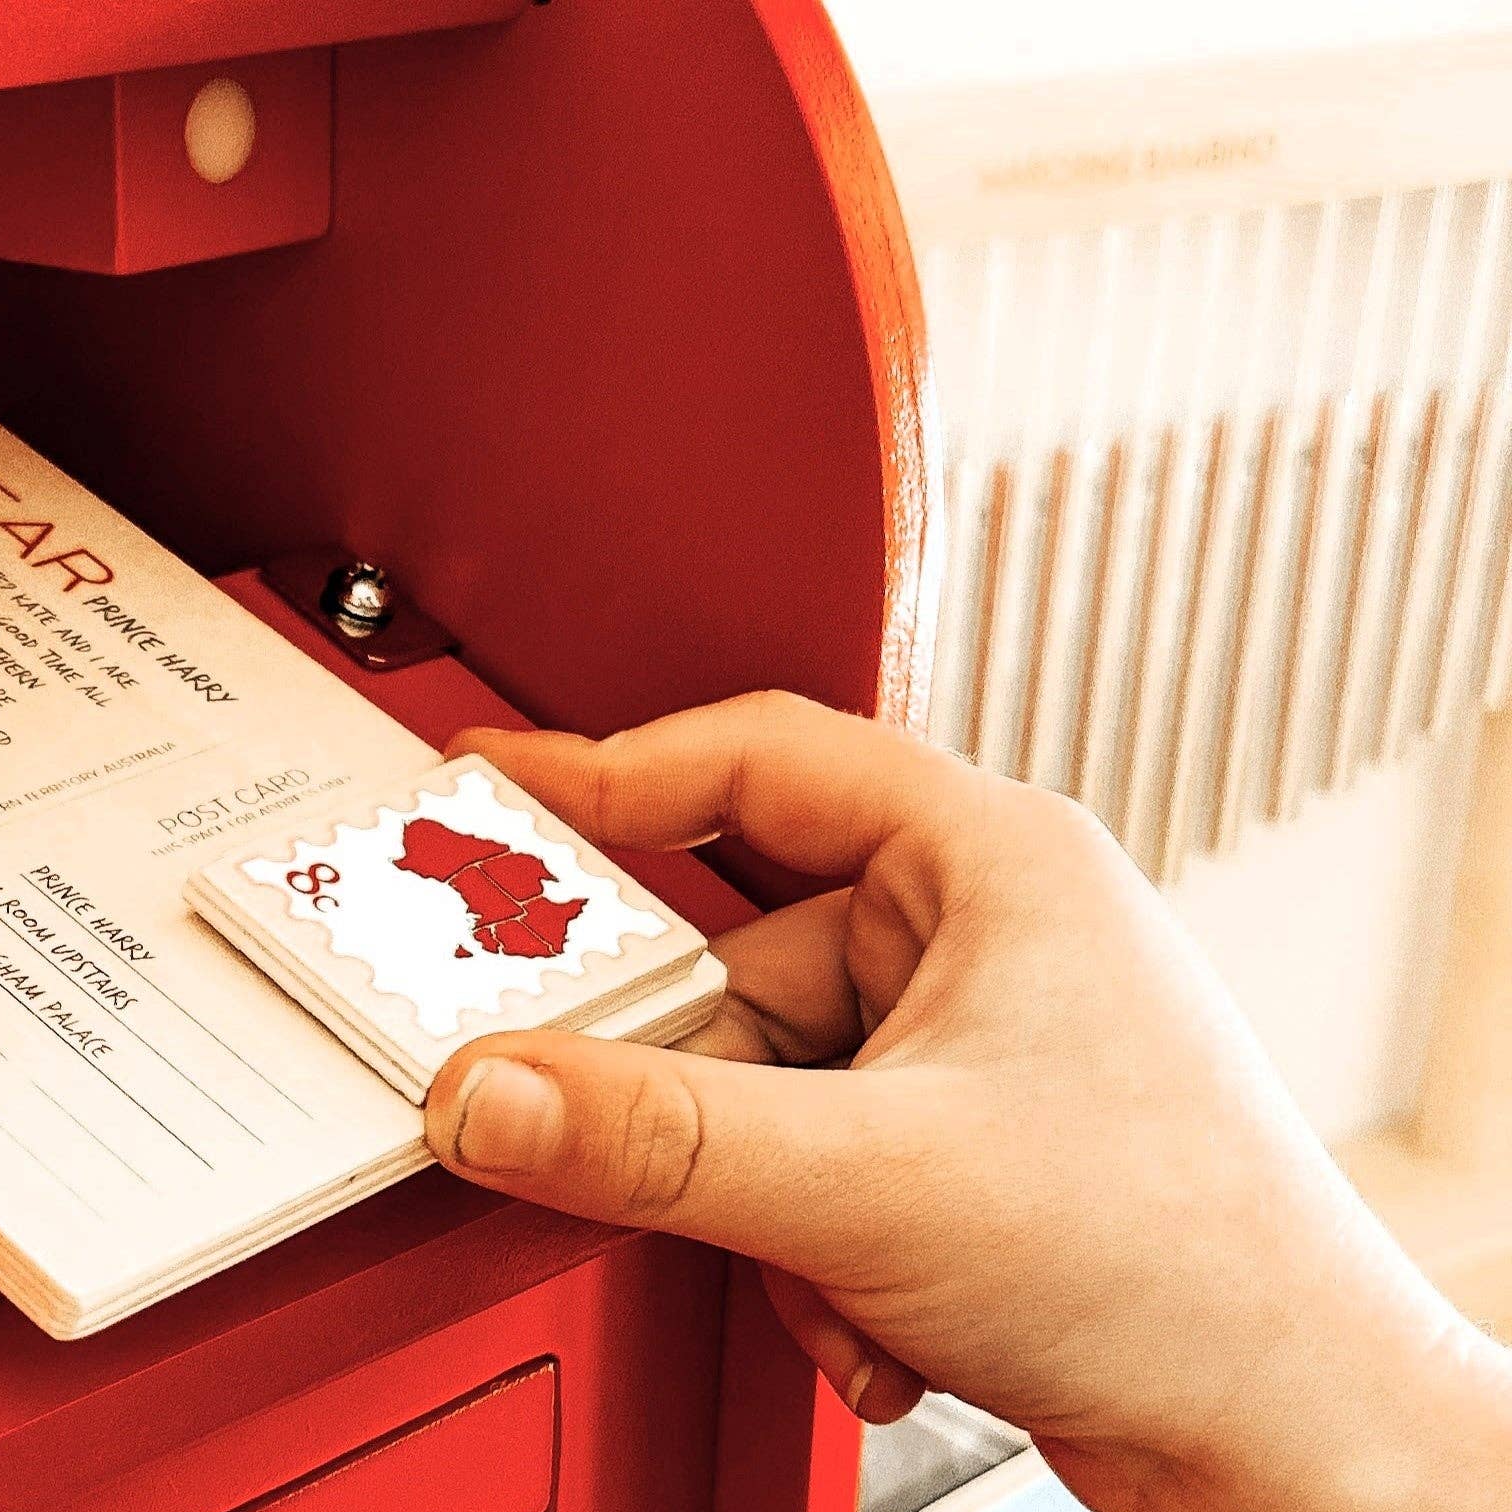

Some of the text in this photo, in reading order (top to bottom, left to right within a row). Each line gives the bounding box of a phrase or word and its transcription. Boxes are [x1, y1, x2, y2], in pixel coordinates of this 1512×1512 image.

[9, 593, 61, 627] KATE
[51, 628, 92, 653] AND
[98, 665, 140, 690] ARE
[81, 595, 166, 652] PRINCE
[155, 653, 239, 703] HARRY
[38, 647, 85, 684] TIME
[75, 685, 112, 708] ALL
[156, 769, 311, 835] POST CARD
[29, 864, 156, 962] PRINCE HARRY
[50, 943, 139, 1011] UPSTAIRS
[39, 1000, 114, 1059] PALACE
